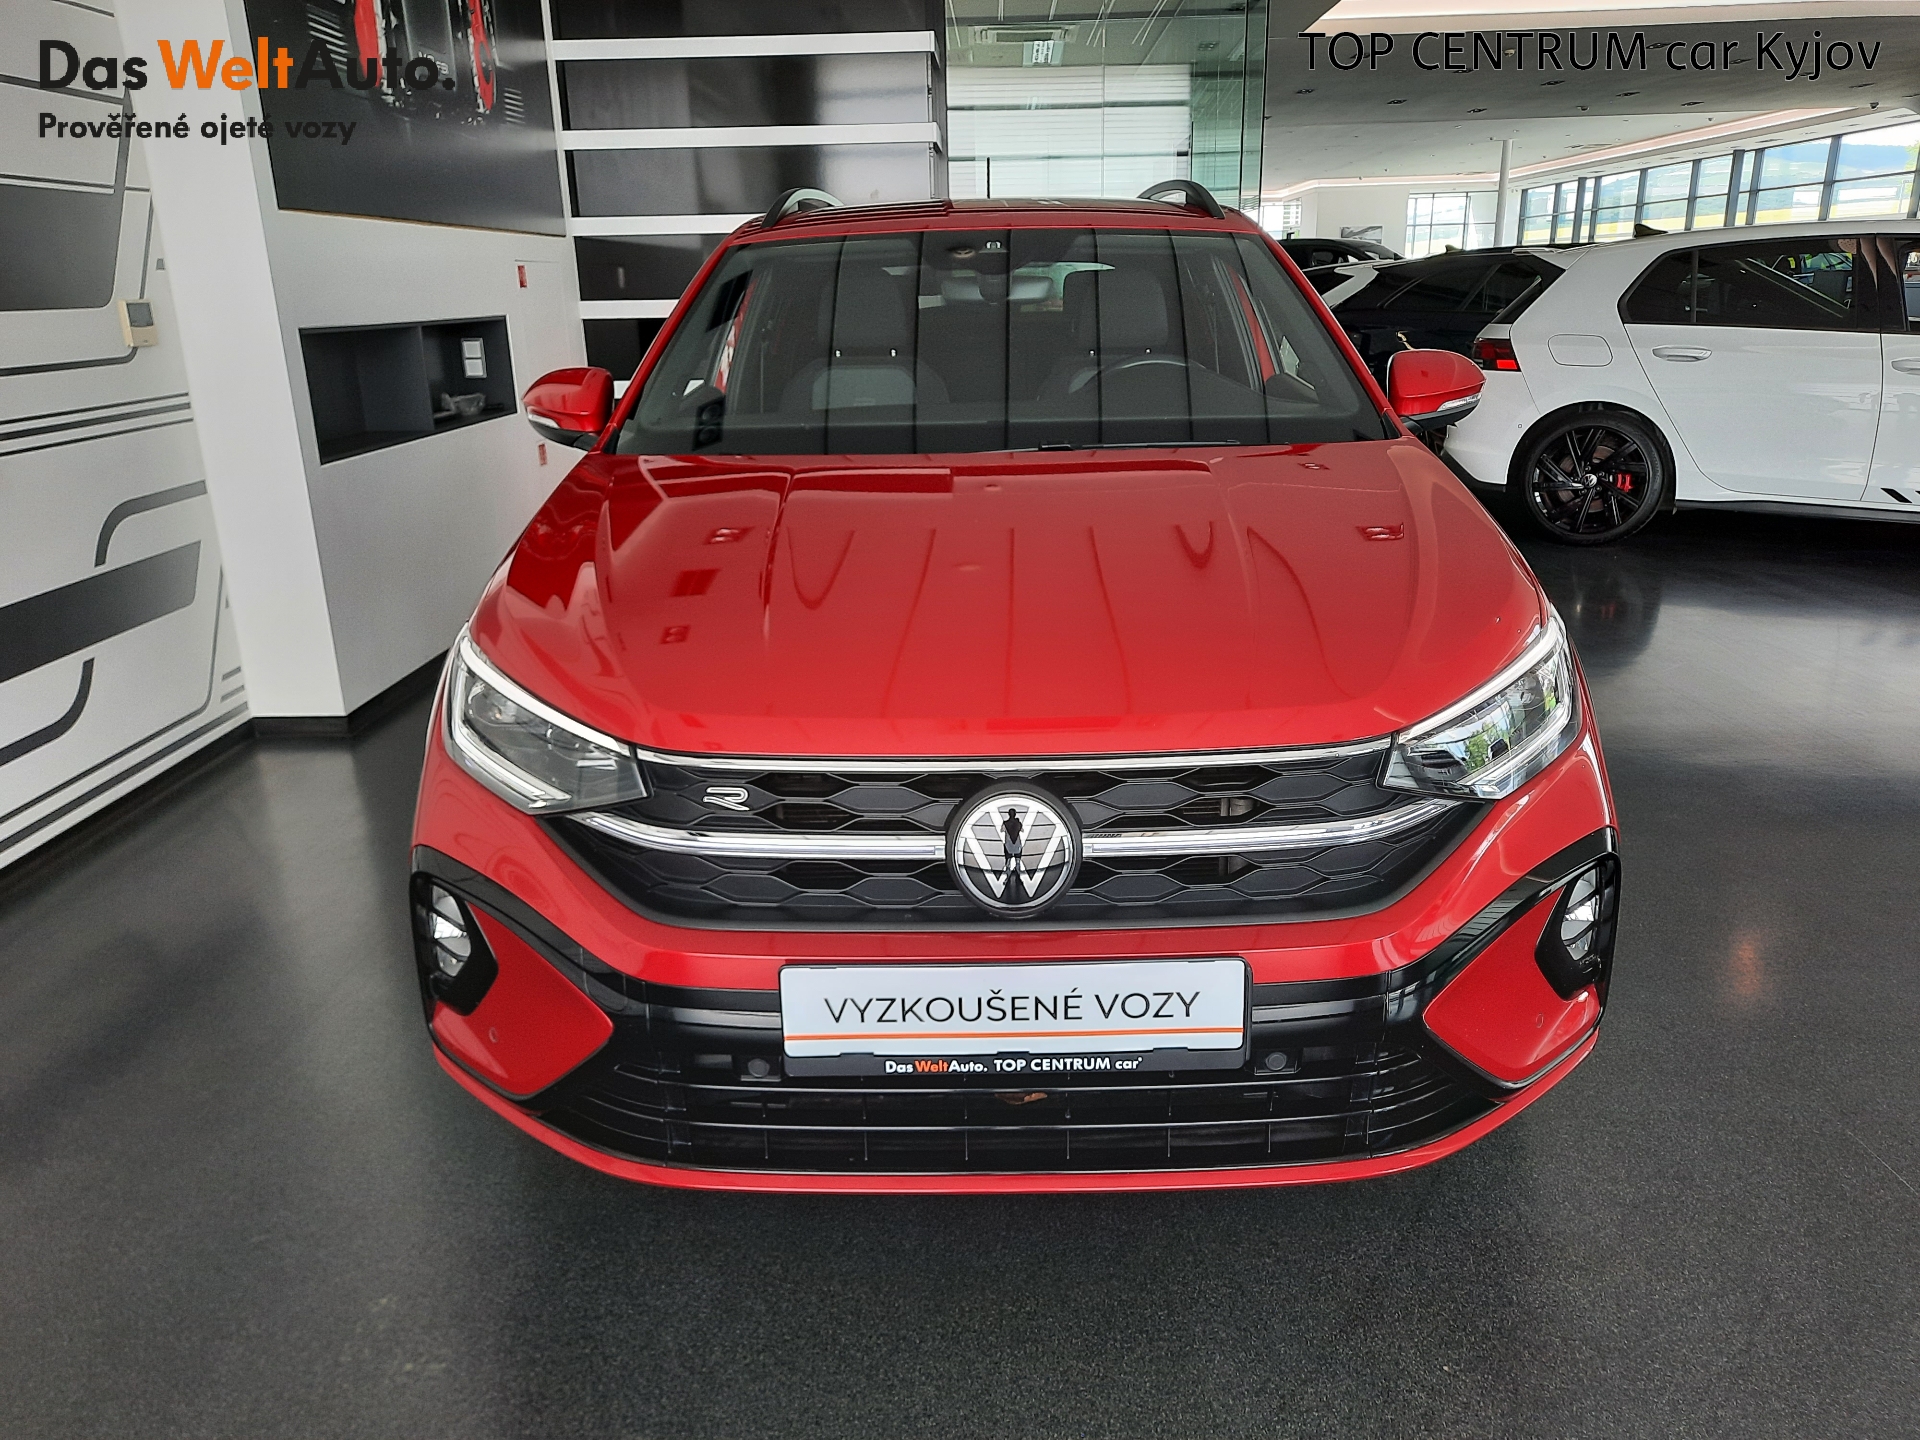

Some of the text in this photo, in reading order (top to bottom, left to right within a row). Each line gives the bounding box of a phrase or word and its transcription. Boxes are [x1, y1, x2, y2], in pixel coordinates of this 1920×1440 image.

[824, 986, 1201, 1024] VYZKOUŠENÉ VOZY
[885, 1060, 914, 1074] Das
[914, 1058, 988, 1073] WeltAuto.
[993, 1058, 1027, 1072] TOP
[1030, 1057, 1111, 1071] CENTRUM
